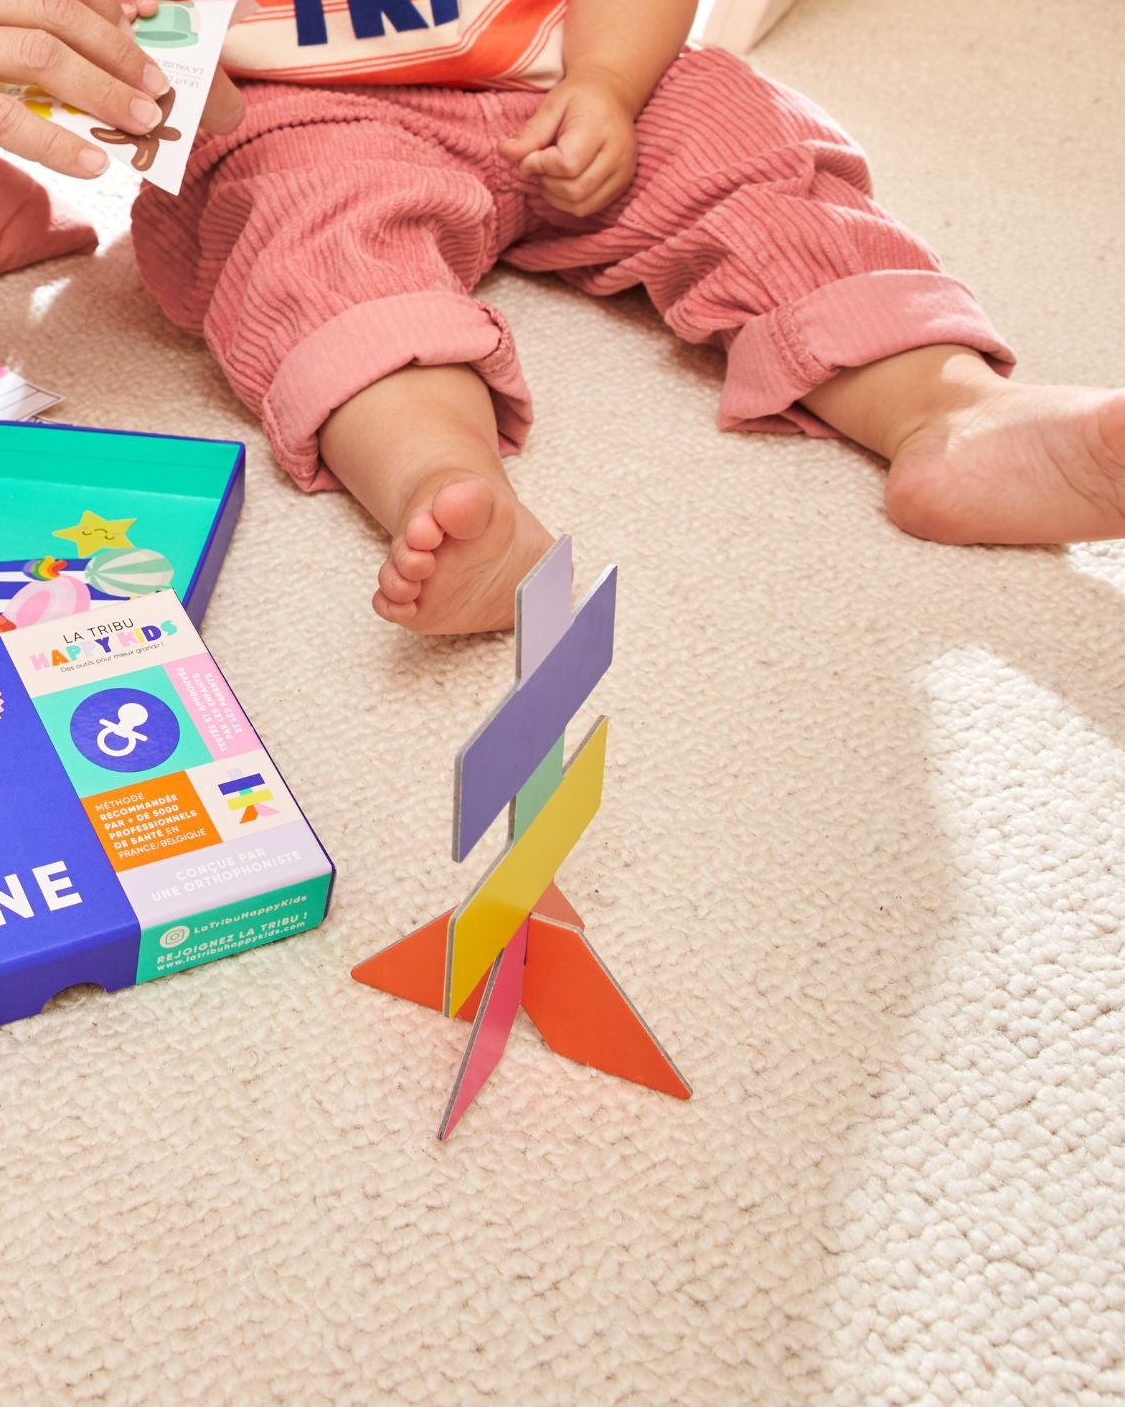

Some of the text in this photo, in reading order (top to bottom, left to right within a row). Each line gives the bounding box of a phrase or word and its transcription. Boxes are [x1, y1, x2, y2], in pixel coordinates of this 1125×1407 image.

[29, 619, 178, 671] HAPPY KIDS
[63, 618, 134, 644] LA TRIBU
[60, 665, 75, 673] Des
[76, 659, 95, 671] outils
[95, 656, 113, 665] pour
[135, 643, 160, 655] grandir
[193, 673, 216, 707] ENFANTS
[202, 713, 213, 723] ET
[211, 707, 224, 722] LES
[224, 707, 236, 723] LES
[95, 792, 145, 812] MÉTHODE
[99, 794, 178, 821] RECOMMANDÉE
[104, 819, 125, 830] PAR
[136, 813, 151, 822] DE
[152, 804, 179, 817] 5000
[108, 809, 198, 840] PROFESSIONNELS
[113, 825, 180, 850] DE SANTÉ EN
[118, 828, 207, 859] FRANCE/BELGIQUE
[151, 850, 303, 902] UNE ORTHOPHONISTE
[175, 847, 267, 881] CONÇUE PAR
[194, 895, 308, 934] LaTribuHappyKids
[156, 933, 235, 965] REJOIGNEZ
[238, 927, 255, 939] LA
[260, 914, 299, 932] TRIBU
[156, 921, 306, 972] www.latribuhappykids.com
